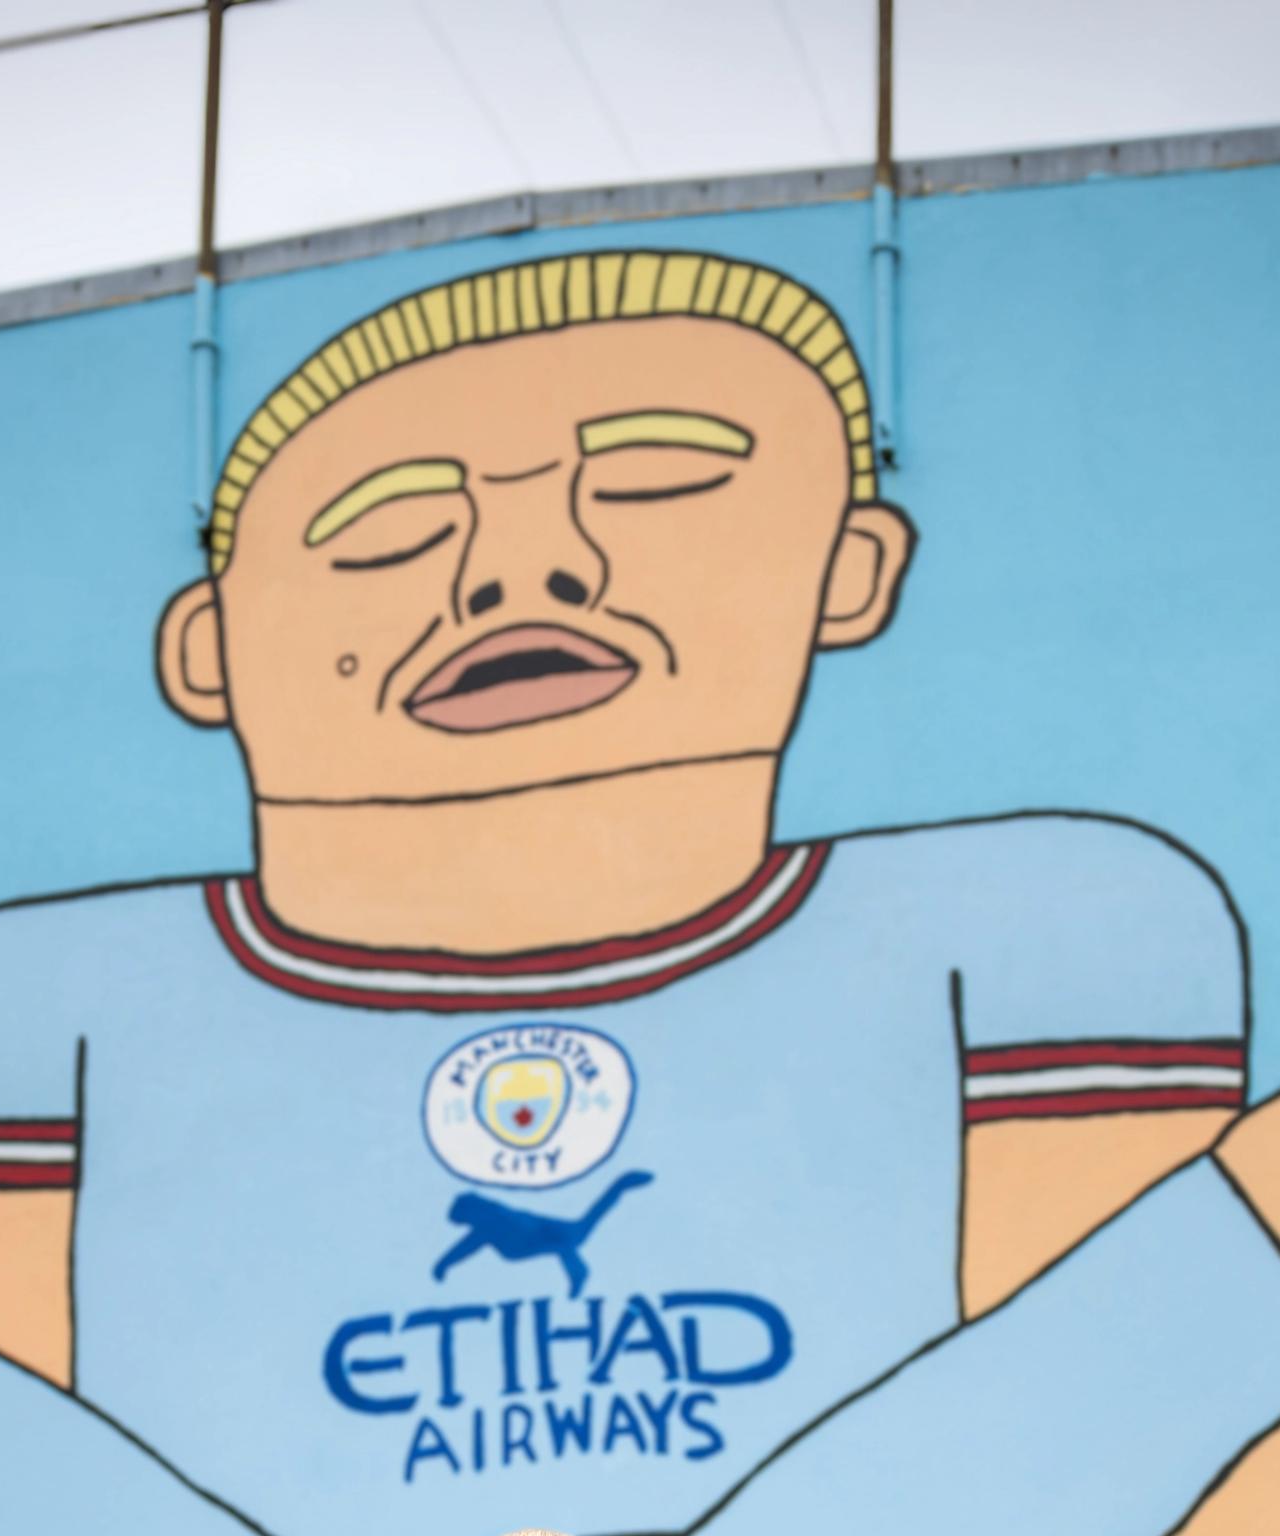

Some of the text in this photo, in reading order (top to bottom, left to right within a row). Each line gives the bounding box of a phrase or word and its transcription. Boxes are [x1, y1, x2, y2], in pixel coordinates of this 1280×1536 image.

[450, 1030, 599, 1087] MANCHESTER
[492, 1148, 563, 1174] CITY
[323, 1291, 793, 1415] ETIHAD
[404, 1388, 725, 1484] AIRWAYS
